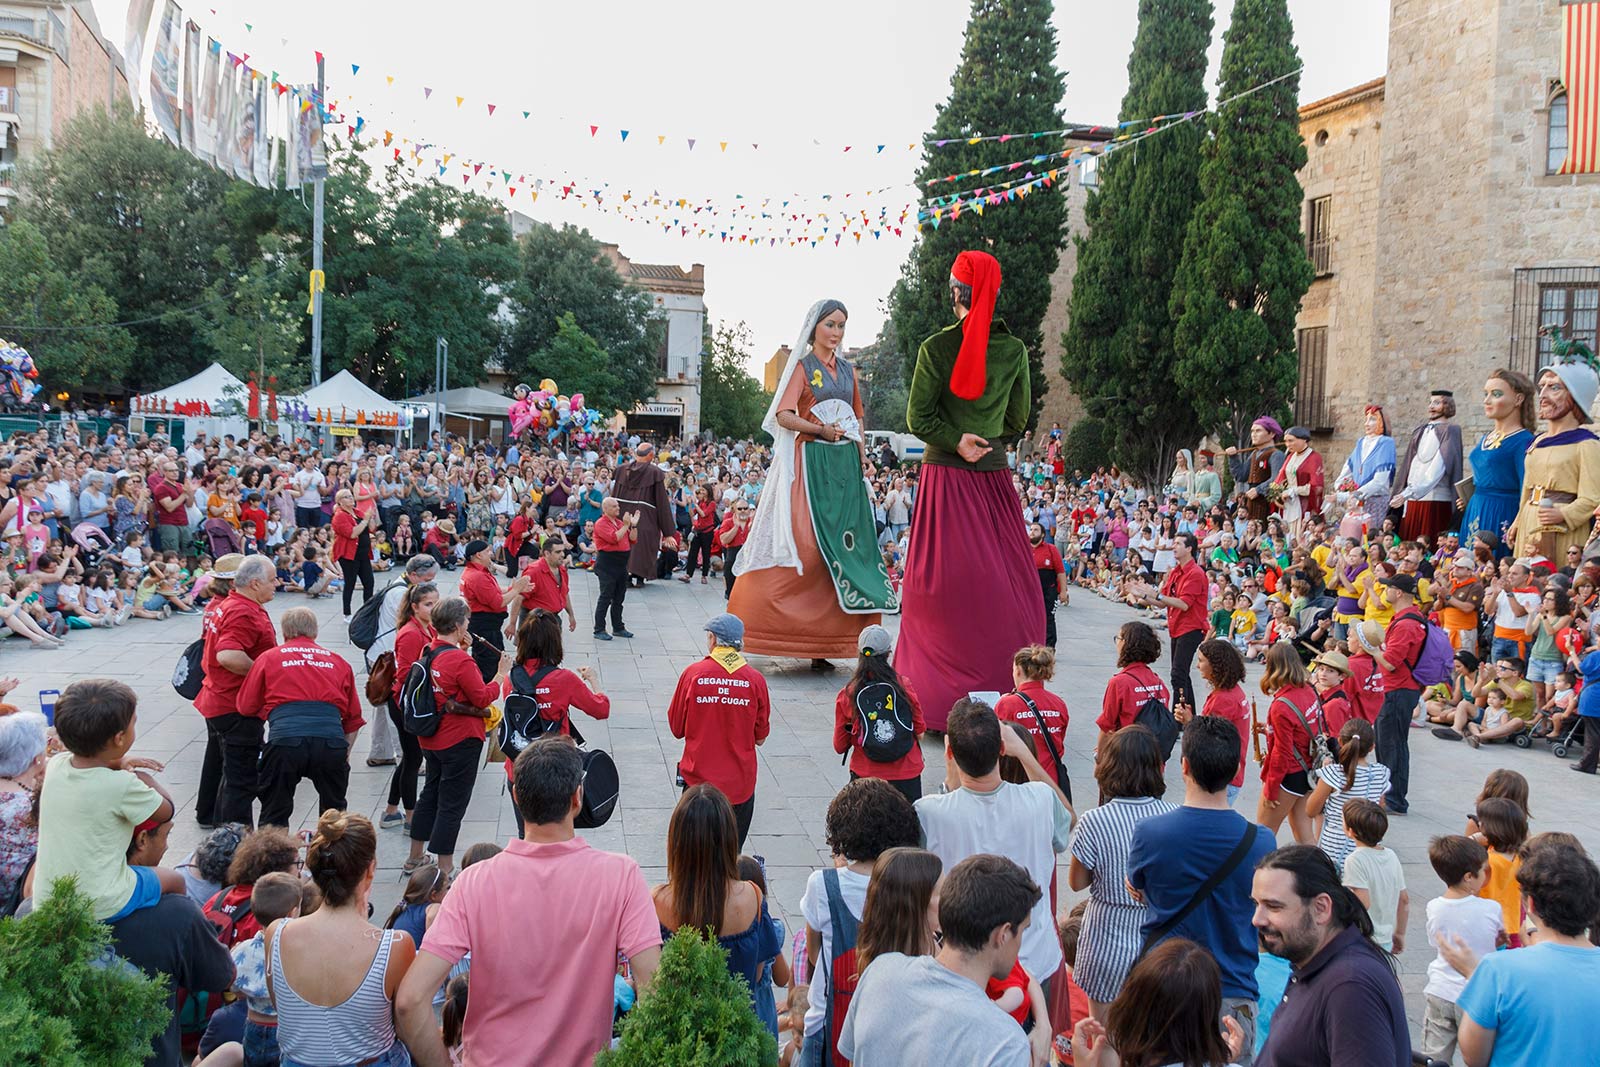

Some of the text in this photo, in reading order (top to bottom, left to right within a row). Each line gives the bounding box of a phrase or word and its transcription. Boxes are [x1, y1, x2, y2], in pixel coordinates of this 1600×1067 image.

[280, 647, 331, 656] GEGANTERS
[306, 660, 335, 669] CUGAT
[697, 678, 750, 688] GEGANTERS
[717, 687, 730, 695] DE
[696, 696, 750, 706] SANT CUGAT
[1016, 710, 1061, 719] GEGNTERS
